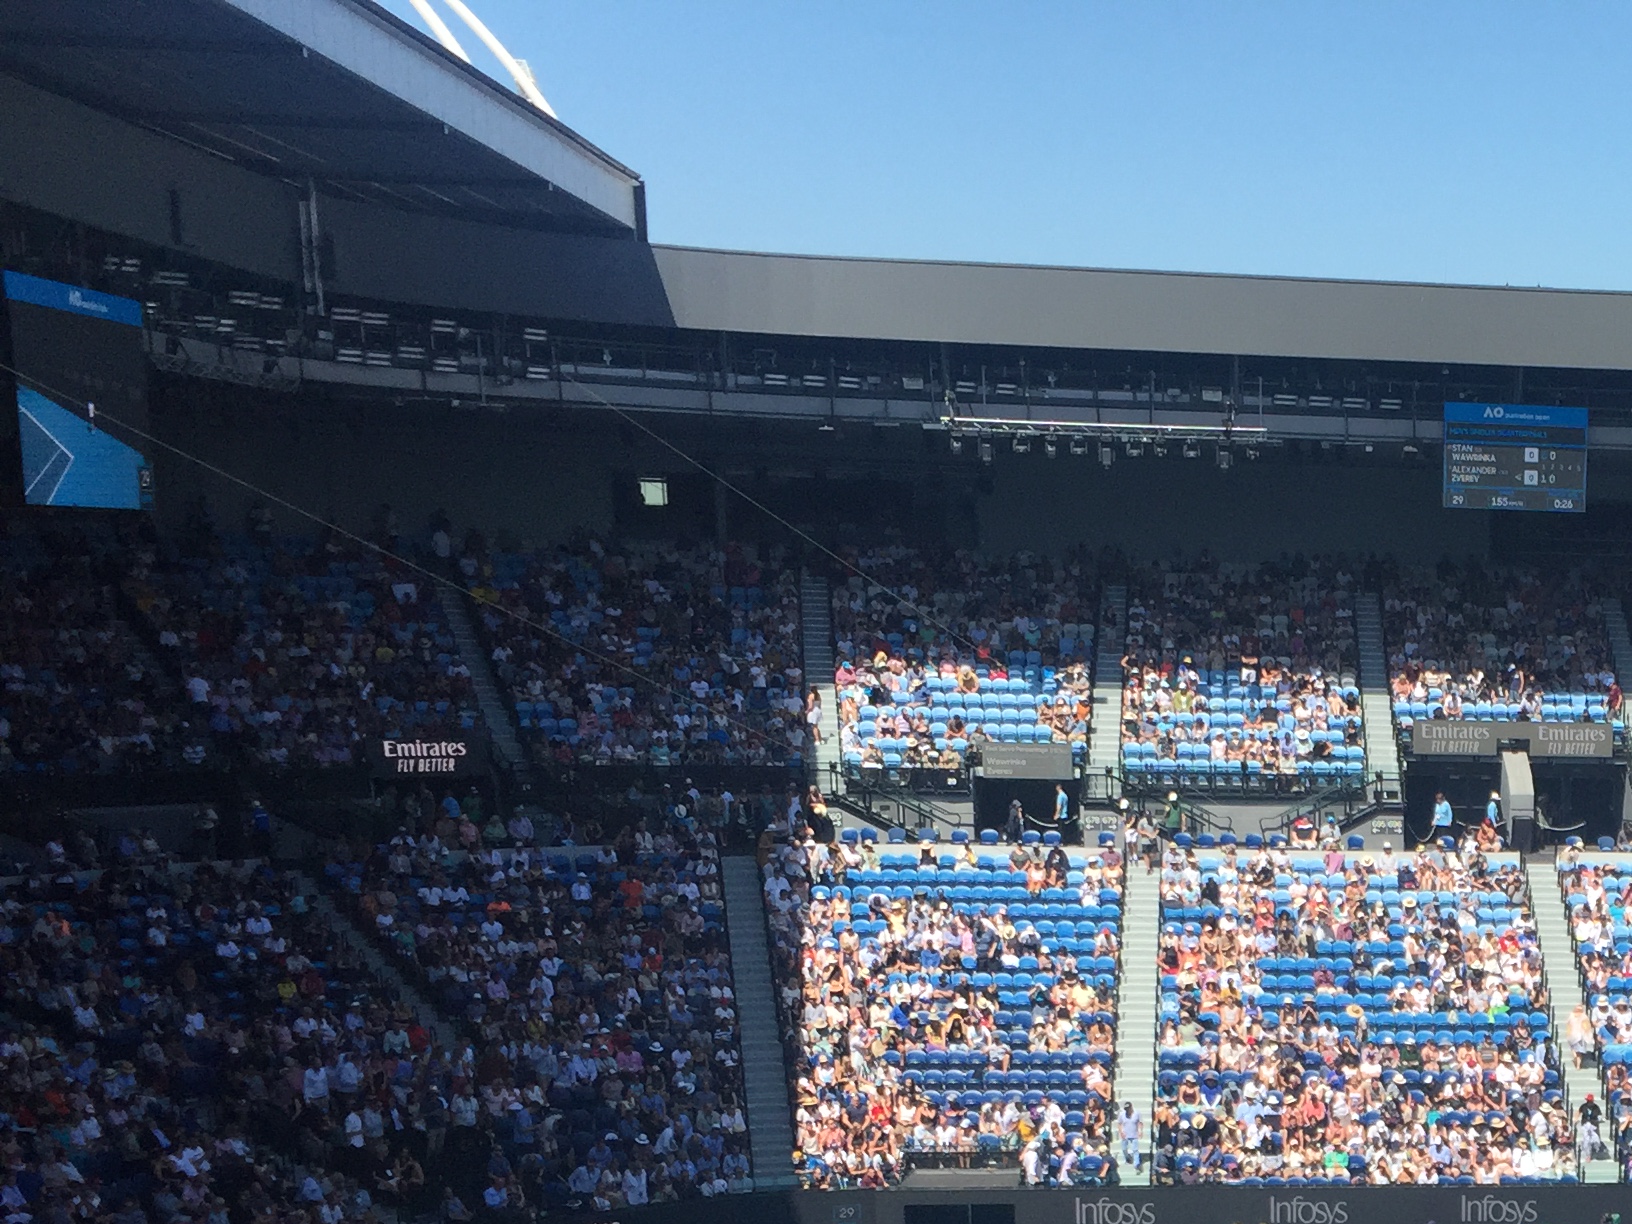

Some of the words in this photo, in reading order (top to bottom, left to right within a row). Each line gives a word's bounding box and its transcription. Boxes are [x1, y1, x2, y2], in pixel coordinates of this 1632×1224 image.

[1452, 444, 1473, 453] STAN
[1452, 453, 1496, 462] WAWRINKA
[1452, 465, 1496, 475] ALEXANDER
[1453, 496, 1464, 505] 29
[1554, 499, 1573, 509] 0:26
[1421, 723, 1490, 739] Emirates
[1538, 725, 1606, 741] Emirates
[383, 740, 466, 757] Emirates
[1431, 740, 1446, 753] FLY
[1449, 741, 1480, 753] BETTER
[1547, 742, 1562, 754] FLY
[1564, 742, 1596, 755] BETTER
[397, 759, 415, 772] FLY
[418, 758, 455, 772] BETTER
[839, 1207, 855, 1218] 29
